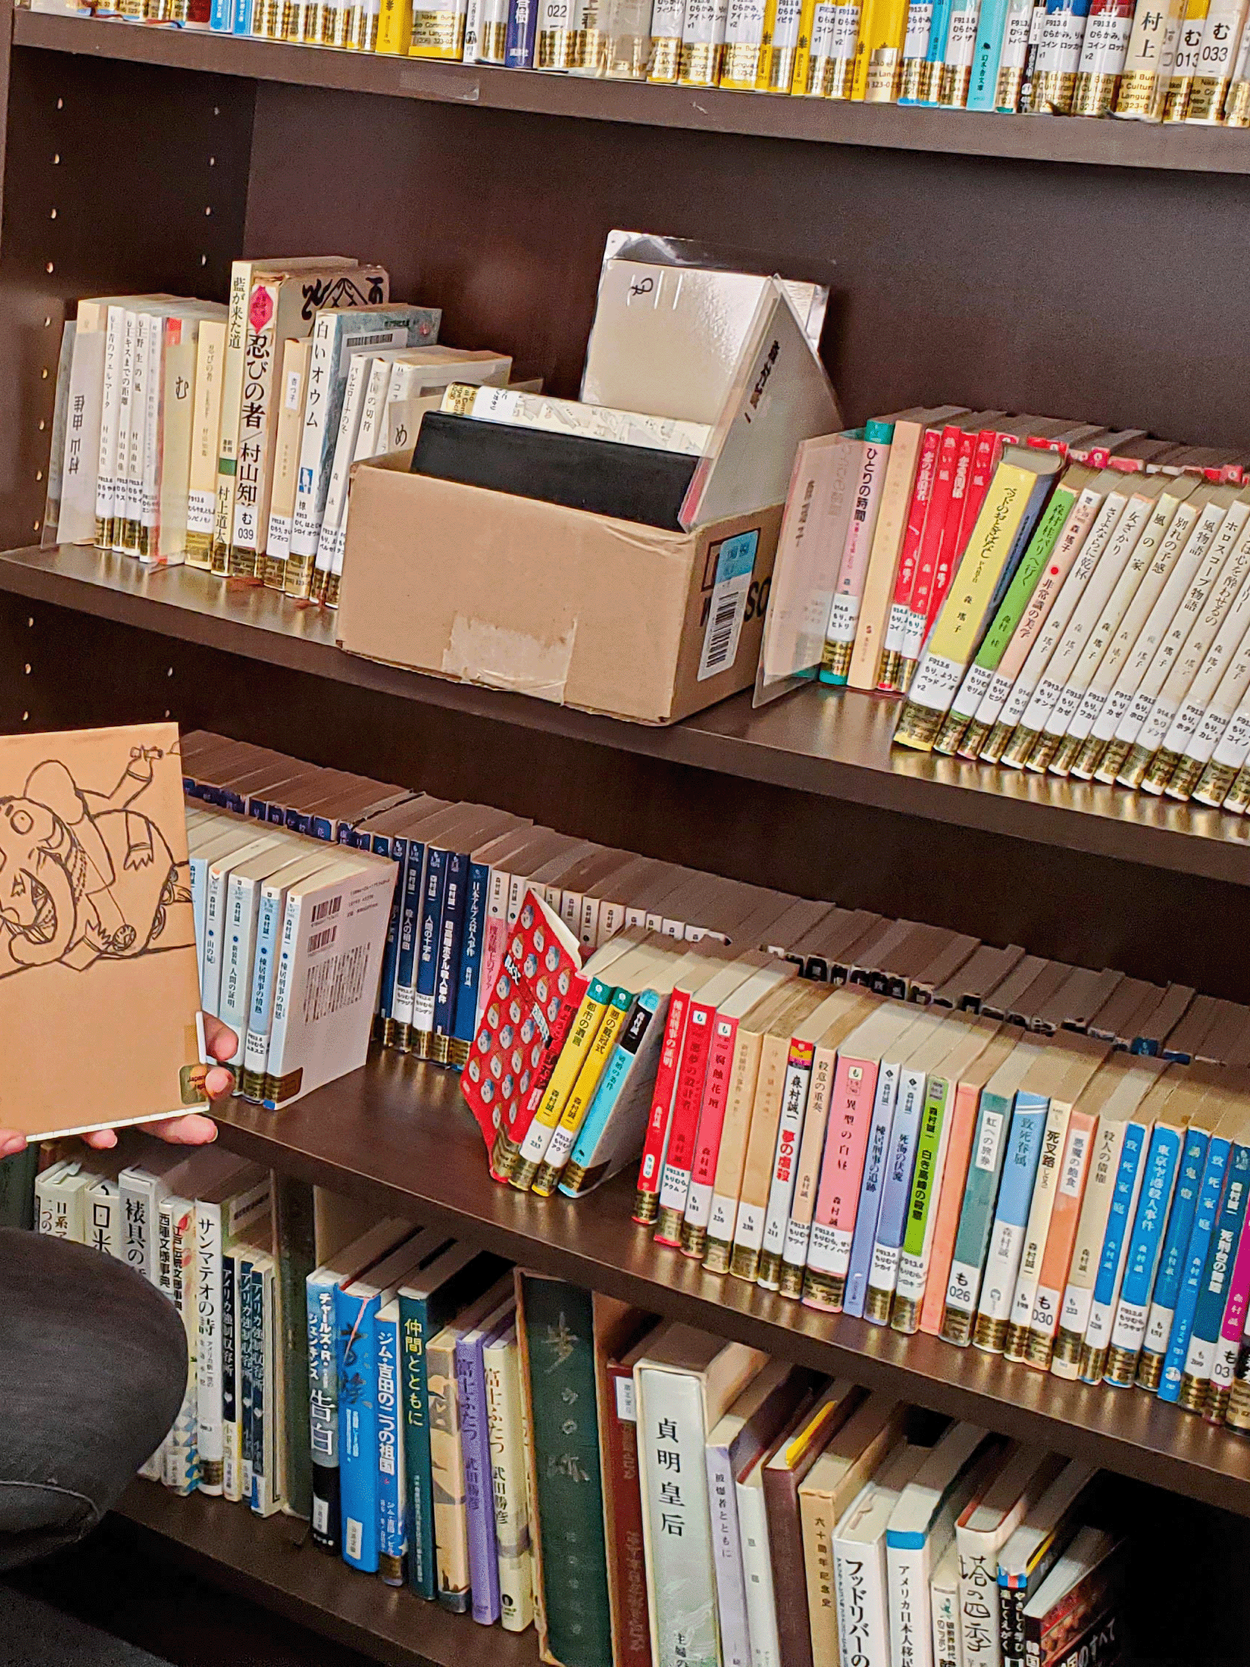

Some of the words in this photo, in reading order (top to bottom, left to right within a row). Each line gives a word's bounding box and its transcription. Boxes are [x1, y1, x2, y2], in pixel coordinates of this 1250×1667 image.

[547, 5, 567, 18] 022
[1093, 20, 1116, 28] F913.6
[1213, 22, 1230, 40] む
[1039, 51, 1046, 59] v1
[1085, 52, 1093, 60] v2
[1135, 11, 1163, 59] 村上
[1184, 30, 1201, 46] む
[1202, 46, 1229, 62] 033
[1176, 52, 1199, 67] 013
[121, 338, 132, 405] キスまでの距離
[134, 338, 144, 392] 野生の風
[176, 376, 189, 399] む
[306, 320, 328, 428] 白いオウム
[239, 334, 270, 507] 忍びの者／村山知
[395, 424, 408, 446] め
[854, 448, 878, 522] ひとりの時間
[238, 528, 254, 540] 039
[242, 512, 252, 525] む
[1112, 511, 1140, 556] 女ざかり
[1190, 520, 1215, 557] 風物語
[1075, 507, 1117, 581] さよならに乾杯
[1130, 513, 1166, 572] 風の家
[1152, 516, 1188, 574] 別れの予感
[1184, 522, 1238, 612] ホロスコープ物語
[466, 881, 481, 957] 日本アルプス殺人事件
[227, 968, 237, 1008] 人間の証明
[786, 1075, 803, 1121] 森村誠一
[981, 1116, 997, 1165] 虹への旅券
[1066, 1138, 1084, 1188] 悪魔の飽食
[1142, 1145, 1170, 1231] 東京空港殺人事件
[768, 1228, 778, 1238] 211
[198, 1218, 214, 1336] サンマテオの詩
[956, 1272, 968, 1286] も
[1024, 1242, 1038, 1275] 森村誠一
[950, 1286, 971, 1302] 026
[1039, 1296, 1051, 1309] も
[1032, 1310, 1053, 1325] 030
[308, 1314, 319, 1380] ジェンキンス
[1224, 1350, 1236, 1364] も
[404, 1318, 424, 1426] 仲間とともに
[1215, 1364, 1236, 1378] 03
[310, 1390, 335, 1455] 告白
[378, 1331, 395, 1475] ジム・吉田の二つの祖国
[656, 1418, 685, 1538] 貞明皇后
[715, 1473, 732, 1557] 被爆者とともに
[845, 1558, 870, 1667] フッドリバーの
[959, 1555, 997, 1652] 塔の四季
